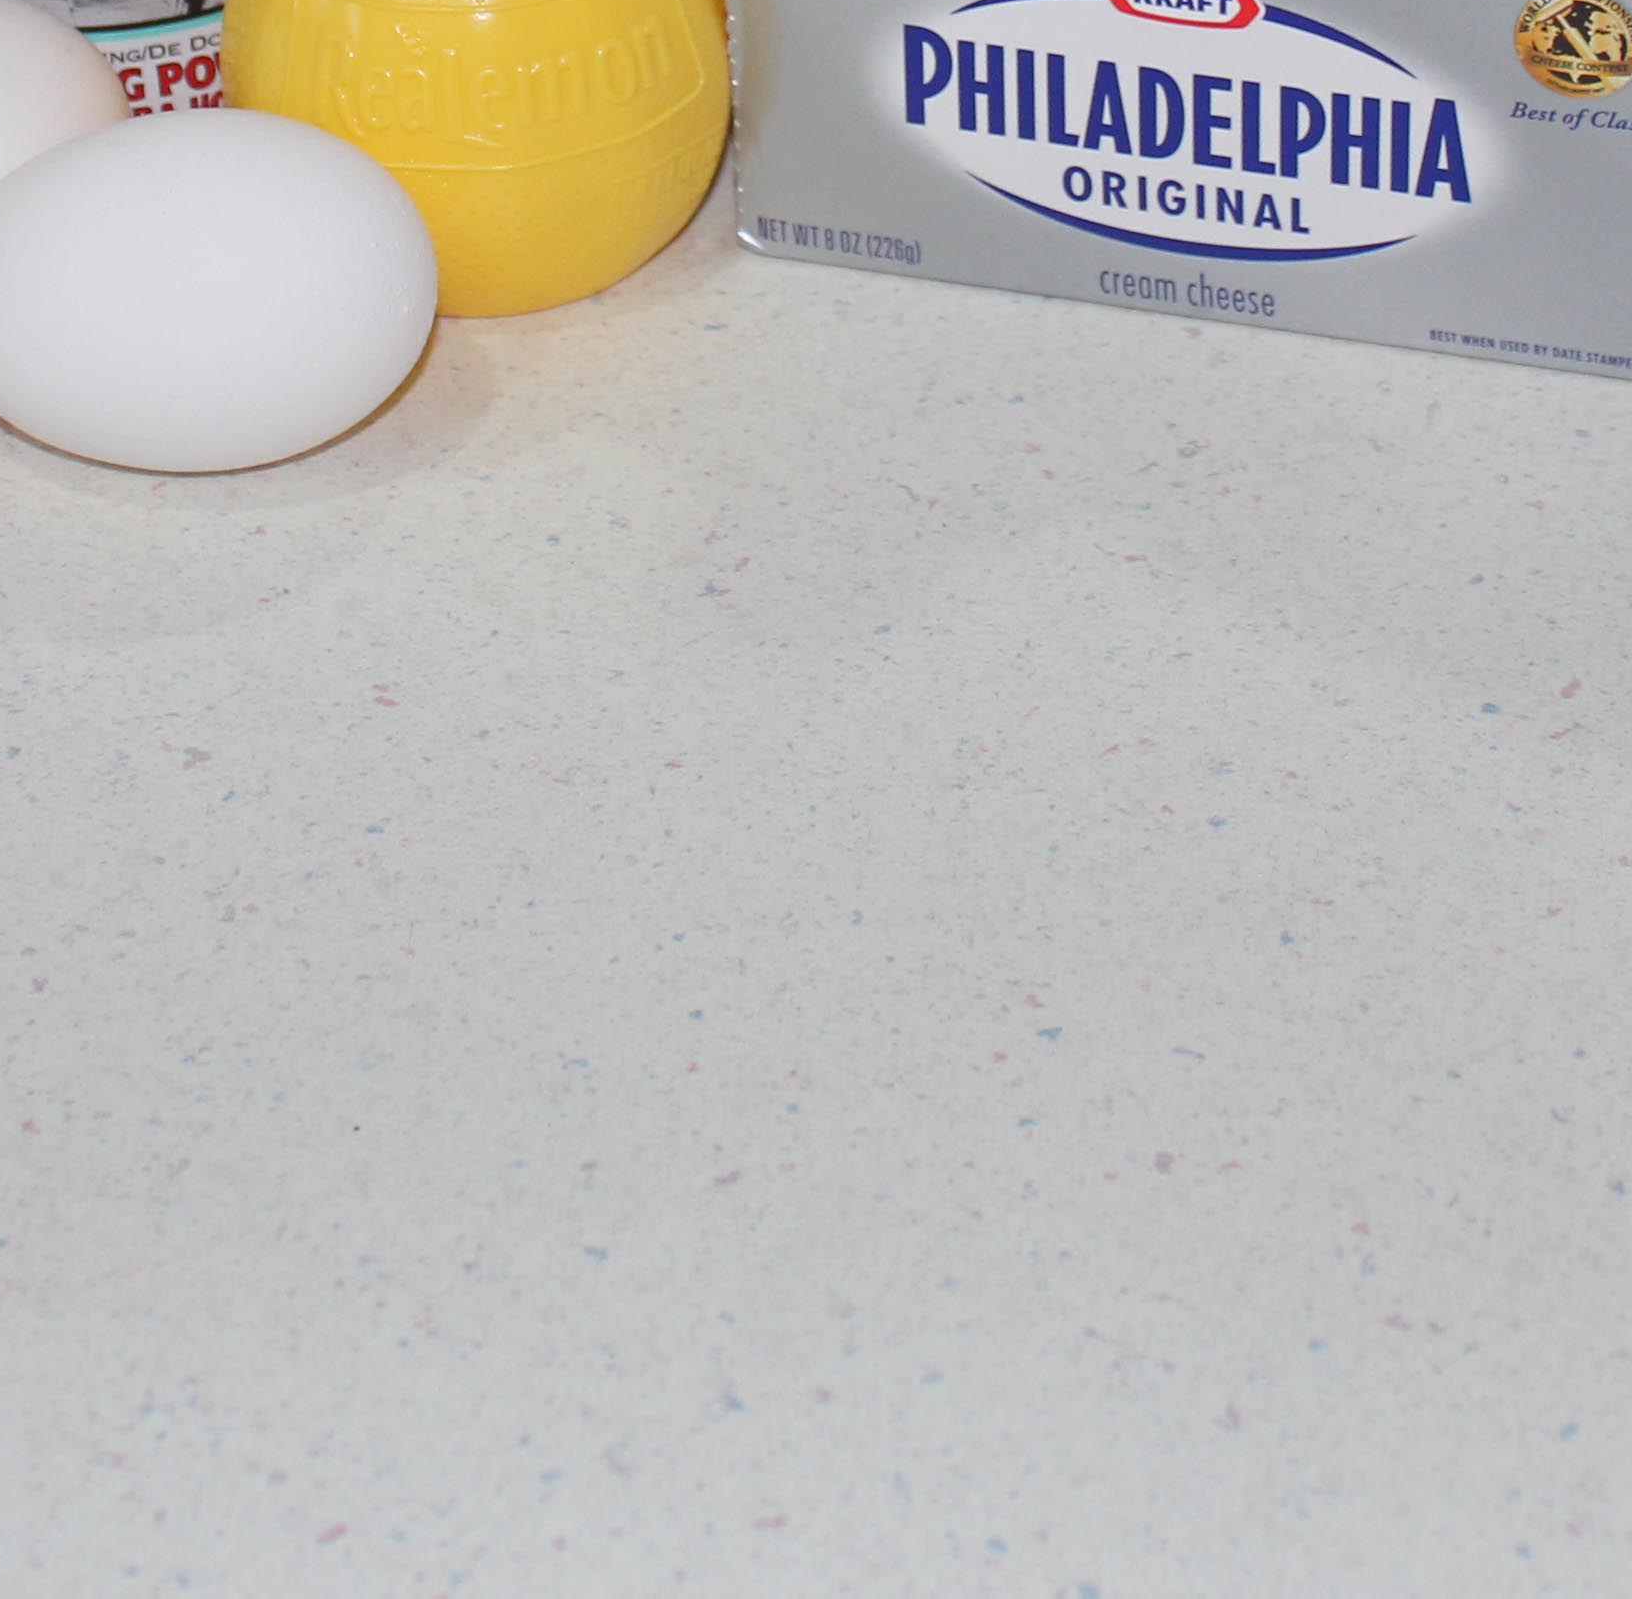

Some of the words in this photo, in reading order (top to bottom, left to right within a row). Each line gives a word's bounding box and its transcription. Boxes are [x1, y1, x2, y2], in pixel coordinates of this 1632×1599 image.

[1531, 55, 1575, 72] CHEESE
[902, 22, 1473, 205] PHILADELPHIA
[1510, 100, 1559, 123] Best
[1561, 108, 1592, 132] of
[1061, 165, 1312, 236] ORIGINAL
[757, 215, 787, 243] NET
[792, 223, 820, 248] WT
[823, 227, 835, 252] 8
[840, 230, 864, 256] OZ
[866, 234, 923, 267] (226g)
[1098, 266, 1177, 304] cream
[1186, 270, 1277, 318] cheese
[1429, 329, 1458, 344] BEST
[1460, 333, 1496, 350] WHEN
[1499, 340, 1530, 355] USED
[1533, 344, 1549, 357] BY
[1552, 346, 1582, 363] DATE
